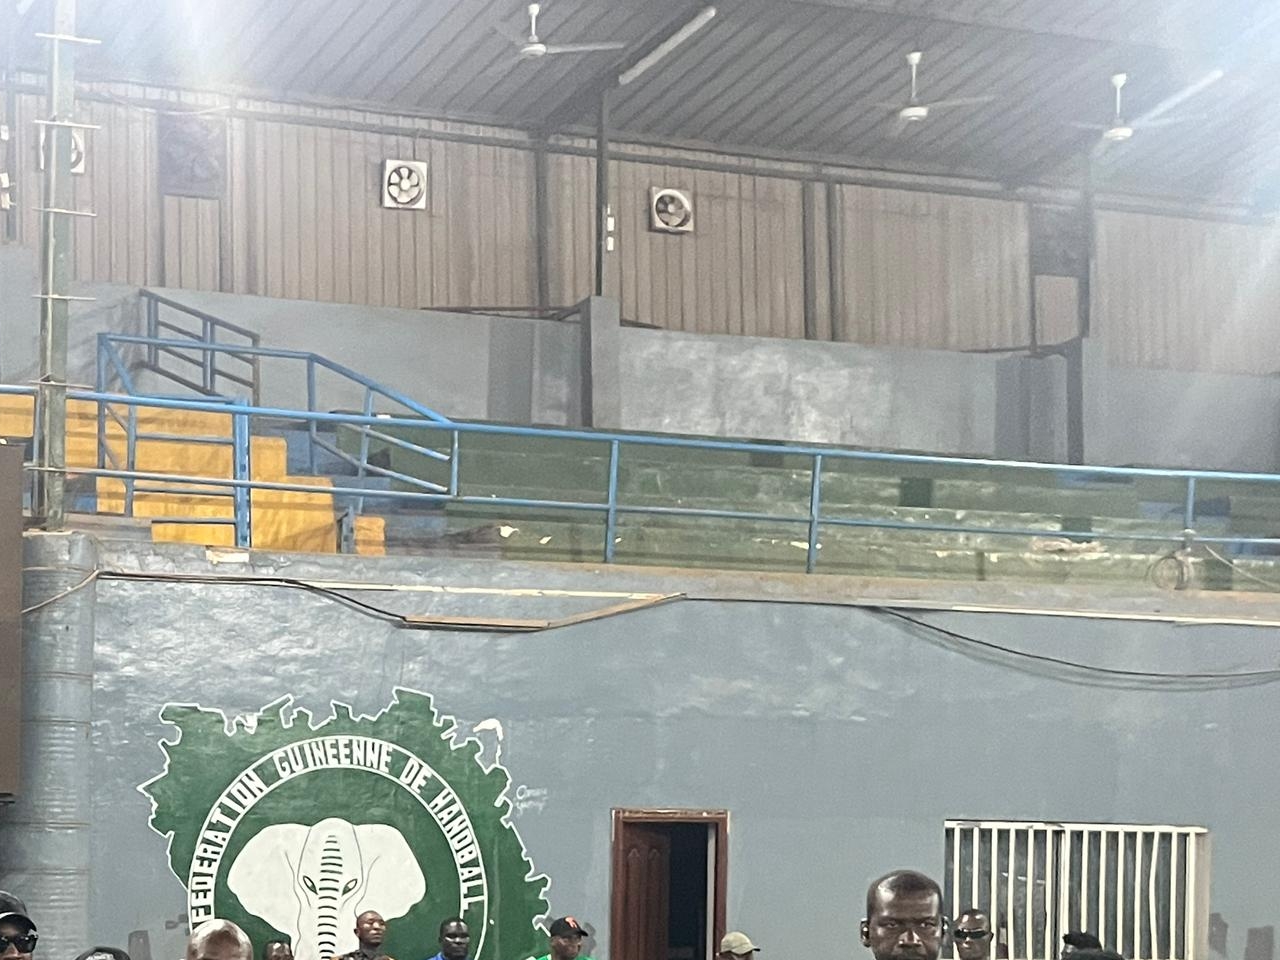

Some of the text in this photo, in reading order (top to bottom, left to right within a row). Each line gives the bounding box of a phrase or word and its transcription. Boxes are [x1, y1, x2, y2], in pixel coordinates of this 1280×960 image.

[191, 739, 486, 922] FEDERATION GUINEENNE DE HANDBALL
